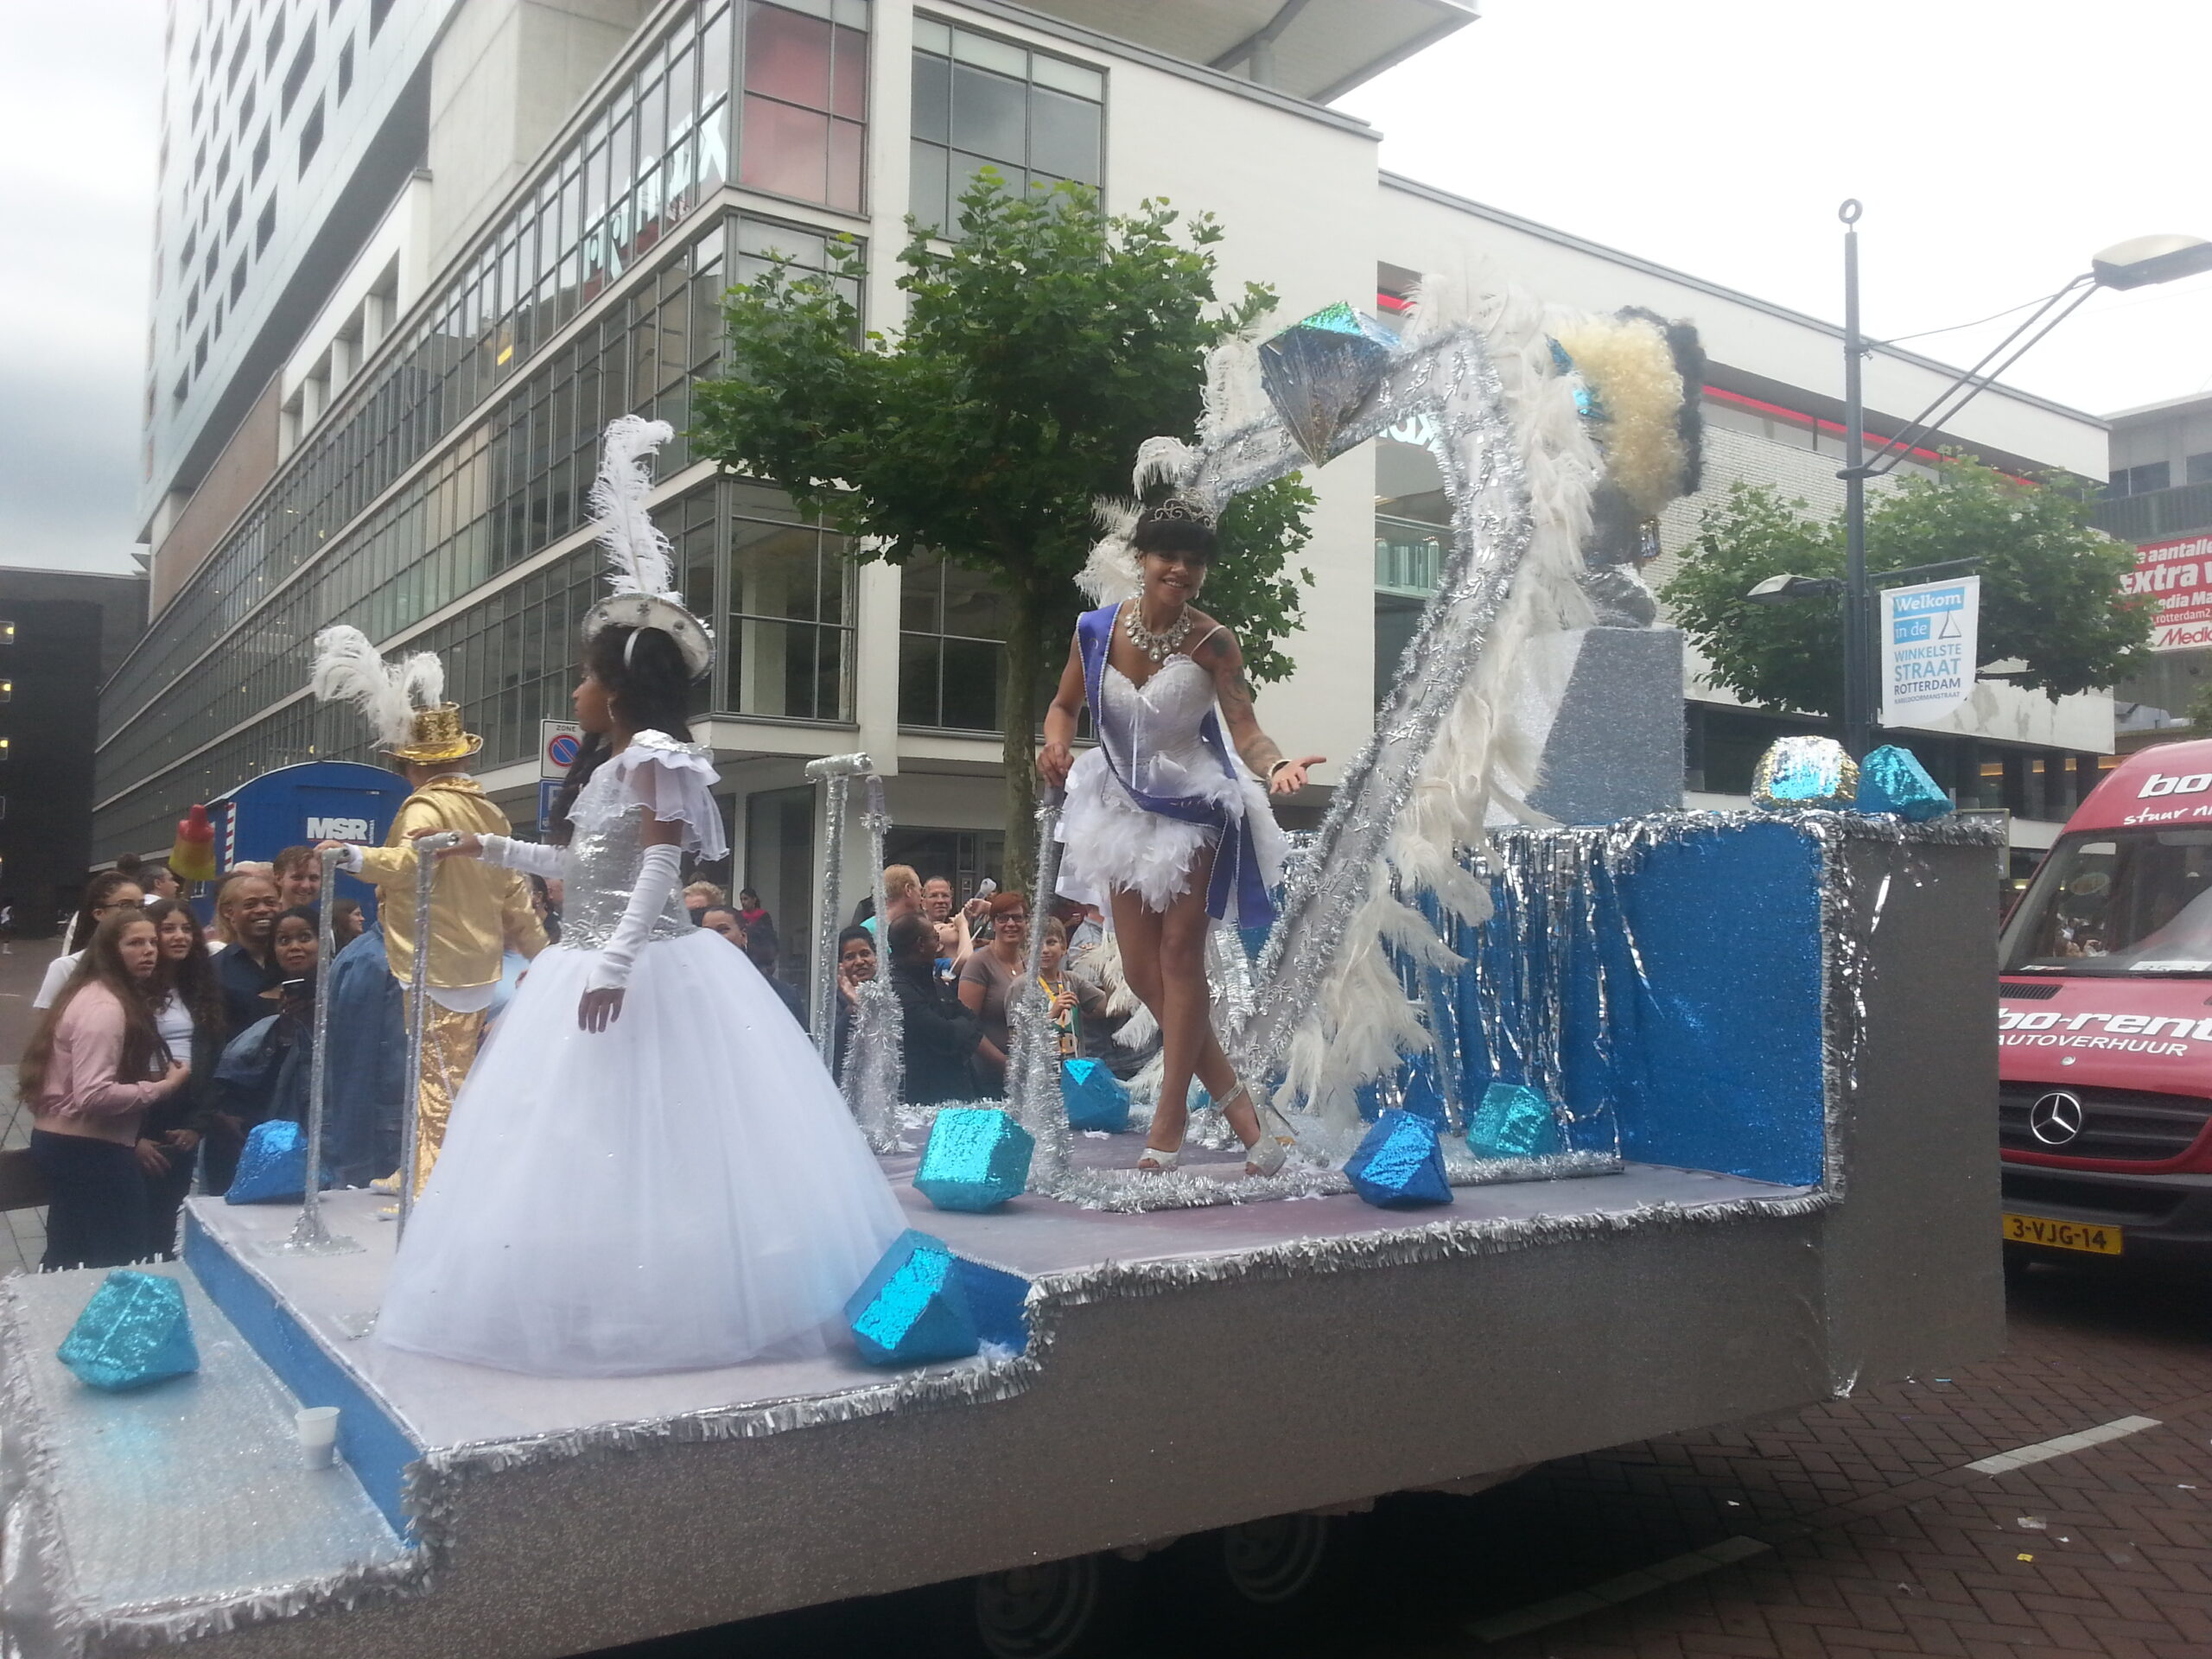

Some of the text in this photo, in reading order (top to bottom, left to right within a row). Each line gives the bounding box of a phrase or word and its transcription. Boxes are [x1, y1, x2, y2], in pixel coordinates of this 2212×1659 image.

[1895, 594, 1962, 612] Welkom
[2158, 594, 2190, 609] edia
[1895, 622, 1928, 639] in de
[1894, 643, 1962, 663] WINKELSTE
[1895, 658, 1961, 683] STRAAT
[1894, 677, 1961, 696] ROTTERDAM
[556, 724, 576, 733] ZONE
[2123, 807, 2189, 825] stuur
[307, 817, 368, 841] MSR
[2012, 1217, 2107, 1249] 3-VJG-14
